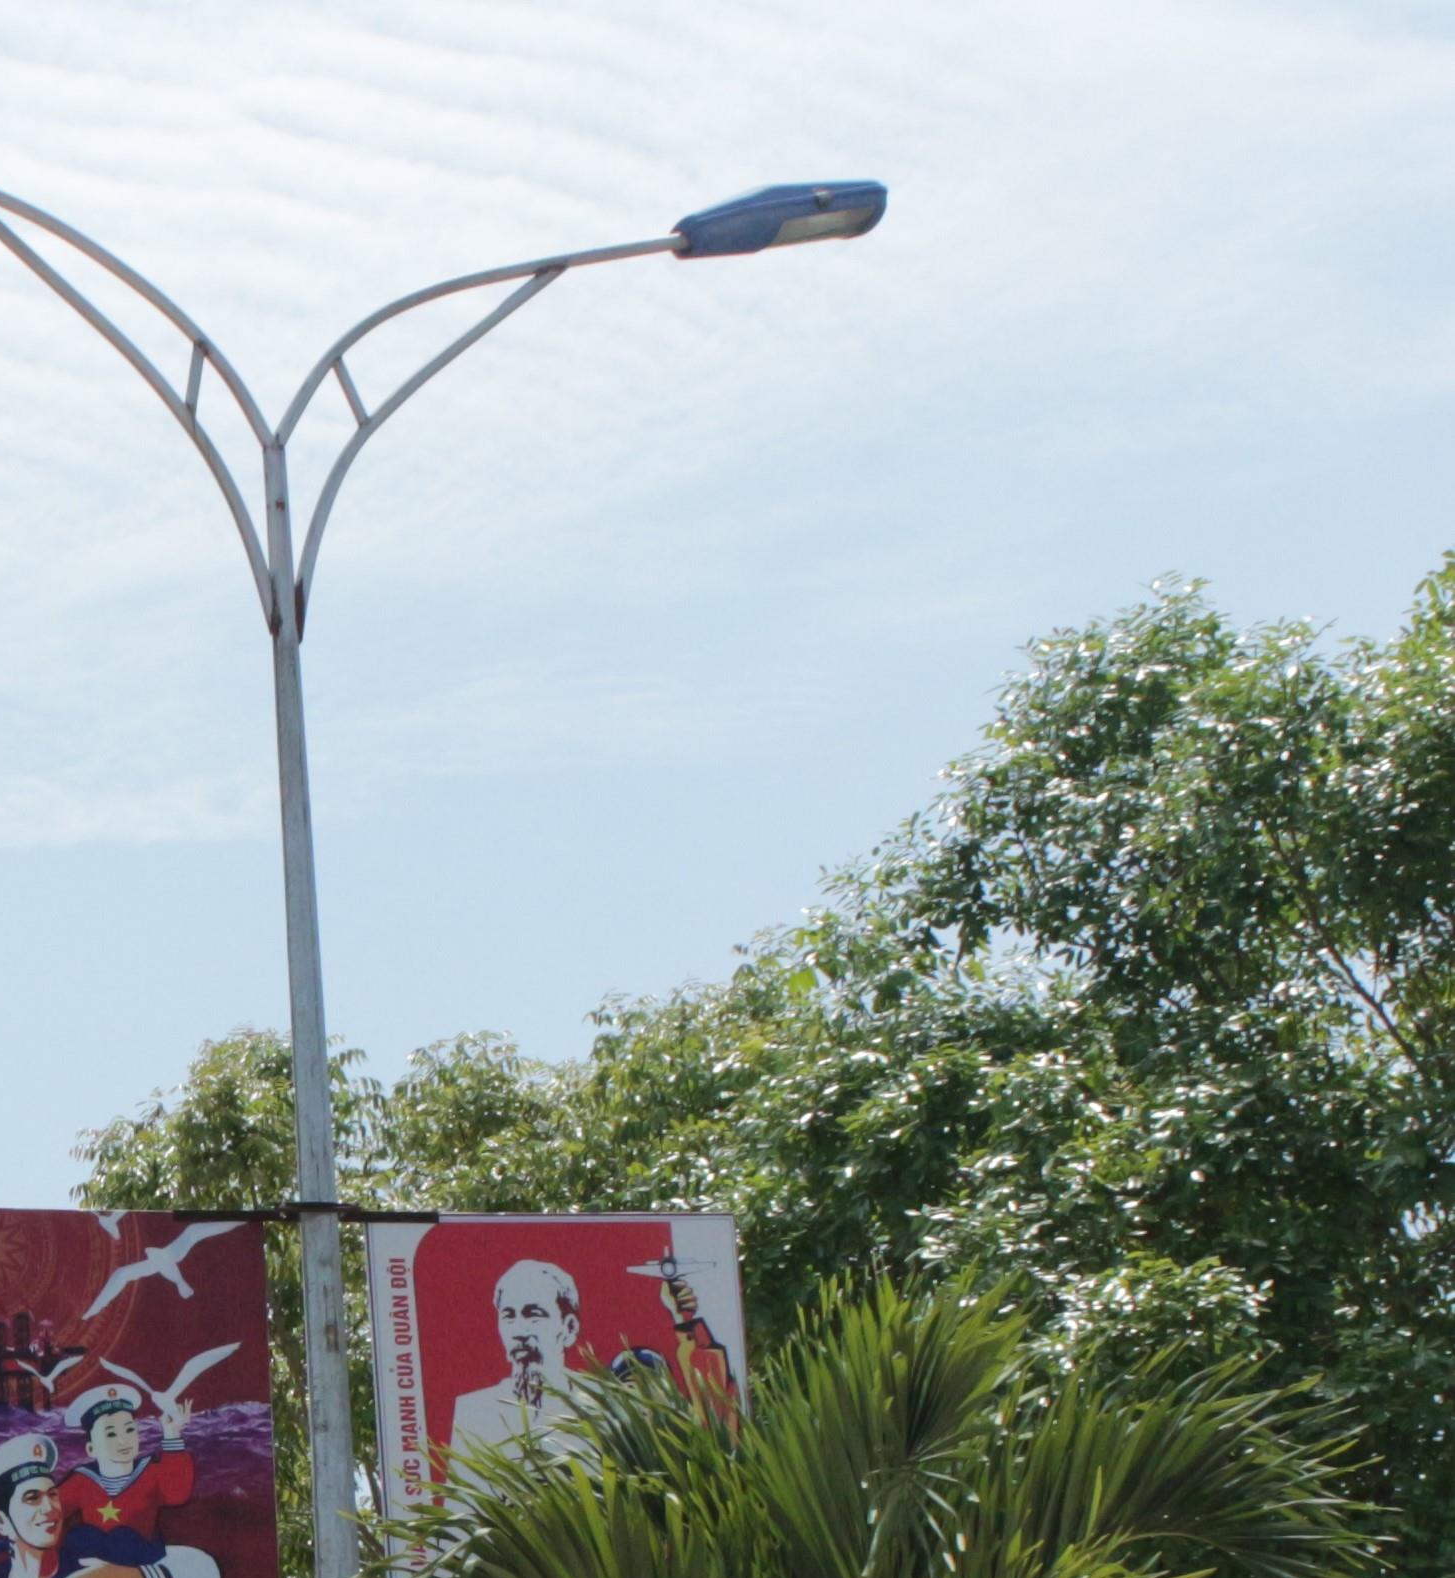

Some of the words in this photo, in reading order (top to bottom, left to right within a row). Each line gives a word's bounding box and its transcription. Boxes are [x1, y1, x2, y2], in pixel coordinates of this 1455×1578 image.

[386, 1257, 411, 1289] ĐỘI
[389, 1295, 413, 1346] QUÂN
[389, 1352, 415, 1389] CỦA
[399, 1396, 423, 1451] MẠNH
